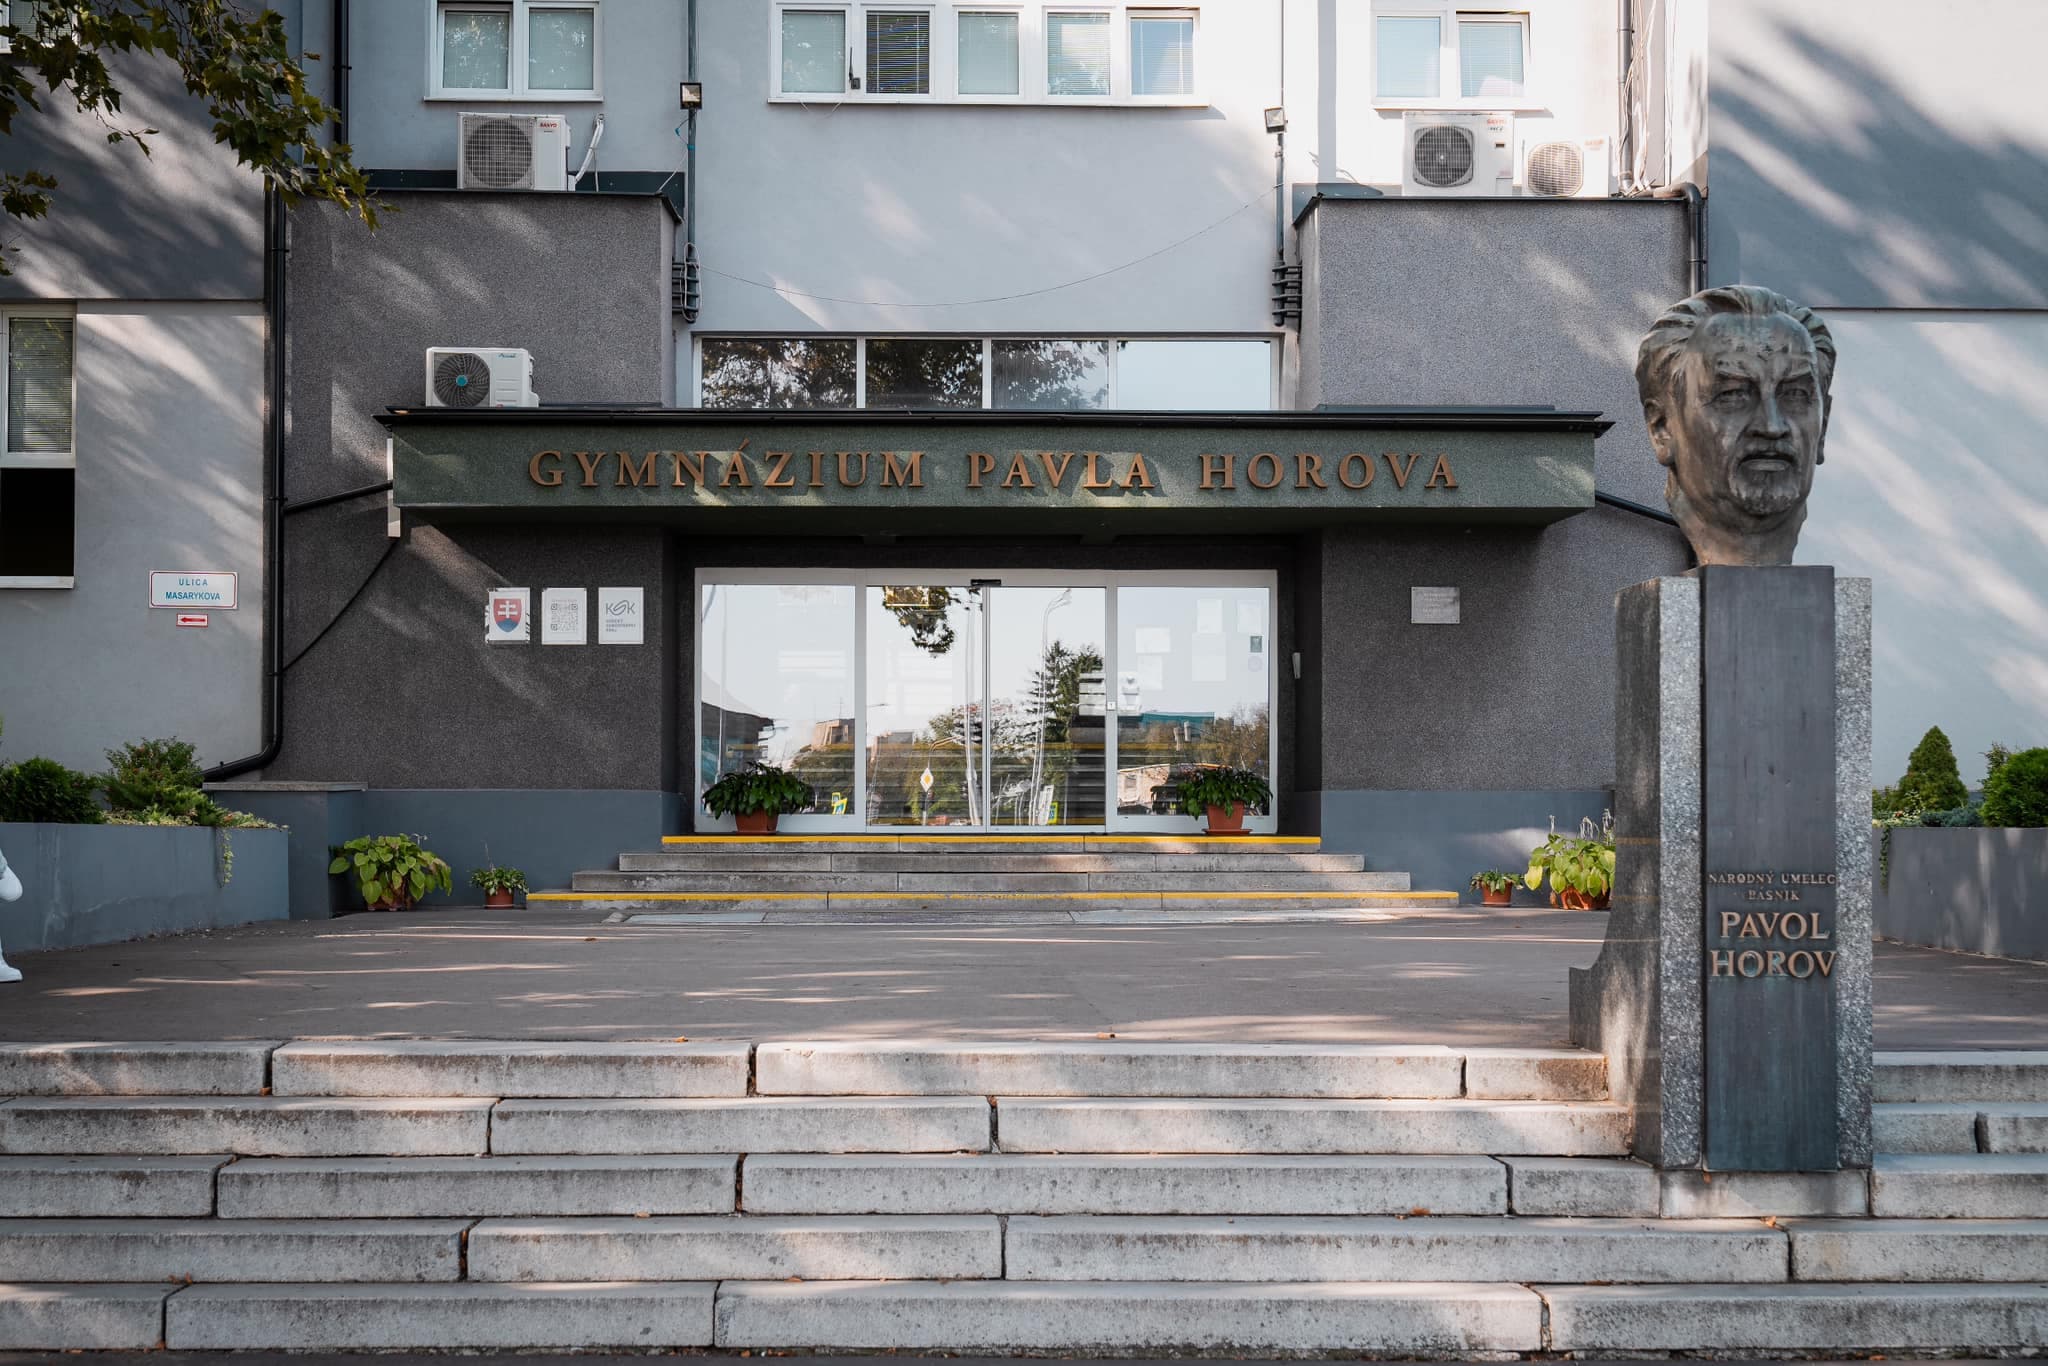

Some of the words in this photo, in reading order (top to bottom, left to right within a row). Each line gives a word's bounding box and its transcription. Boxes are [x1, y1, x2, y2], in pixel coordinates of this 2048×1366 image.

[528, 437, 926, 488] GYMNÁZIUM
[967, 452, 1156, 488] PAVLA
[1199, 452, 1459, 489] HOROVA
[178, 578, 208, 586] ULICA
[165, 591, 221, 600] MASARYKOVA
[1781, 873, 1836, 884] UMELEC
[1720, 911, 1831, 940] PAVOL
[1709, 949, 1837, 978] HOROV
